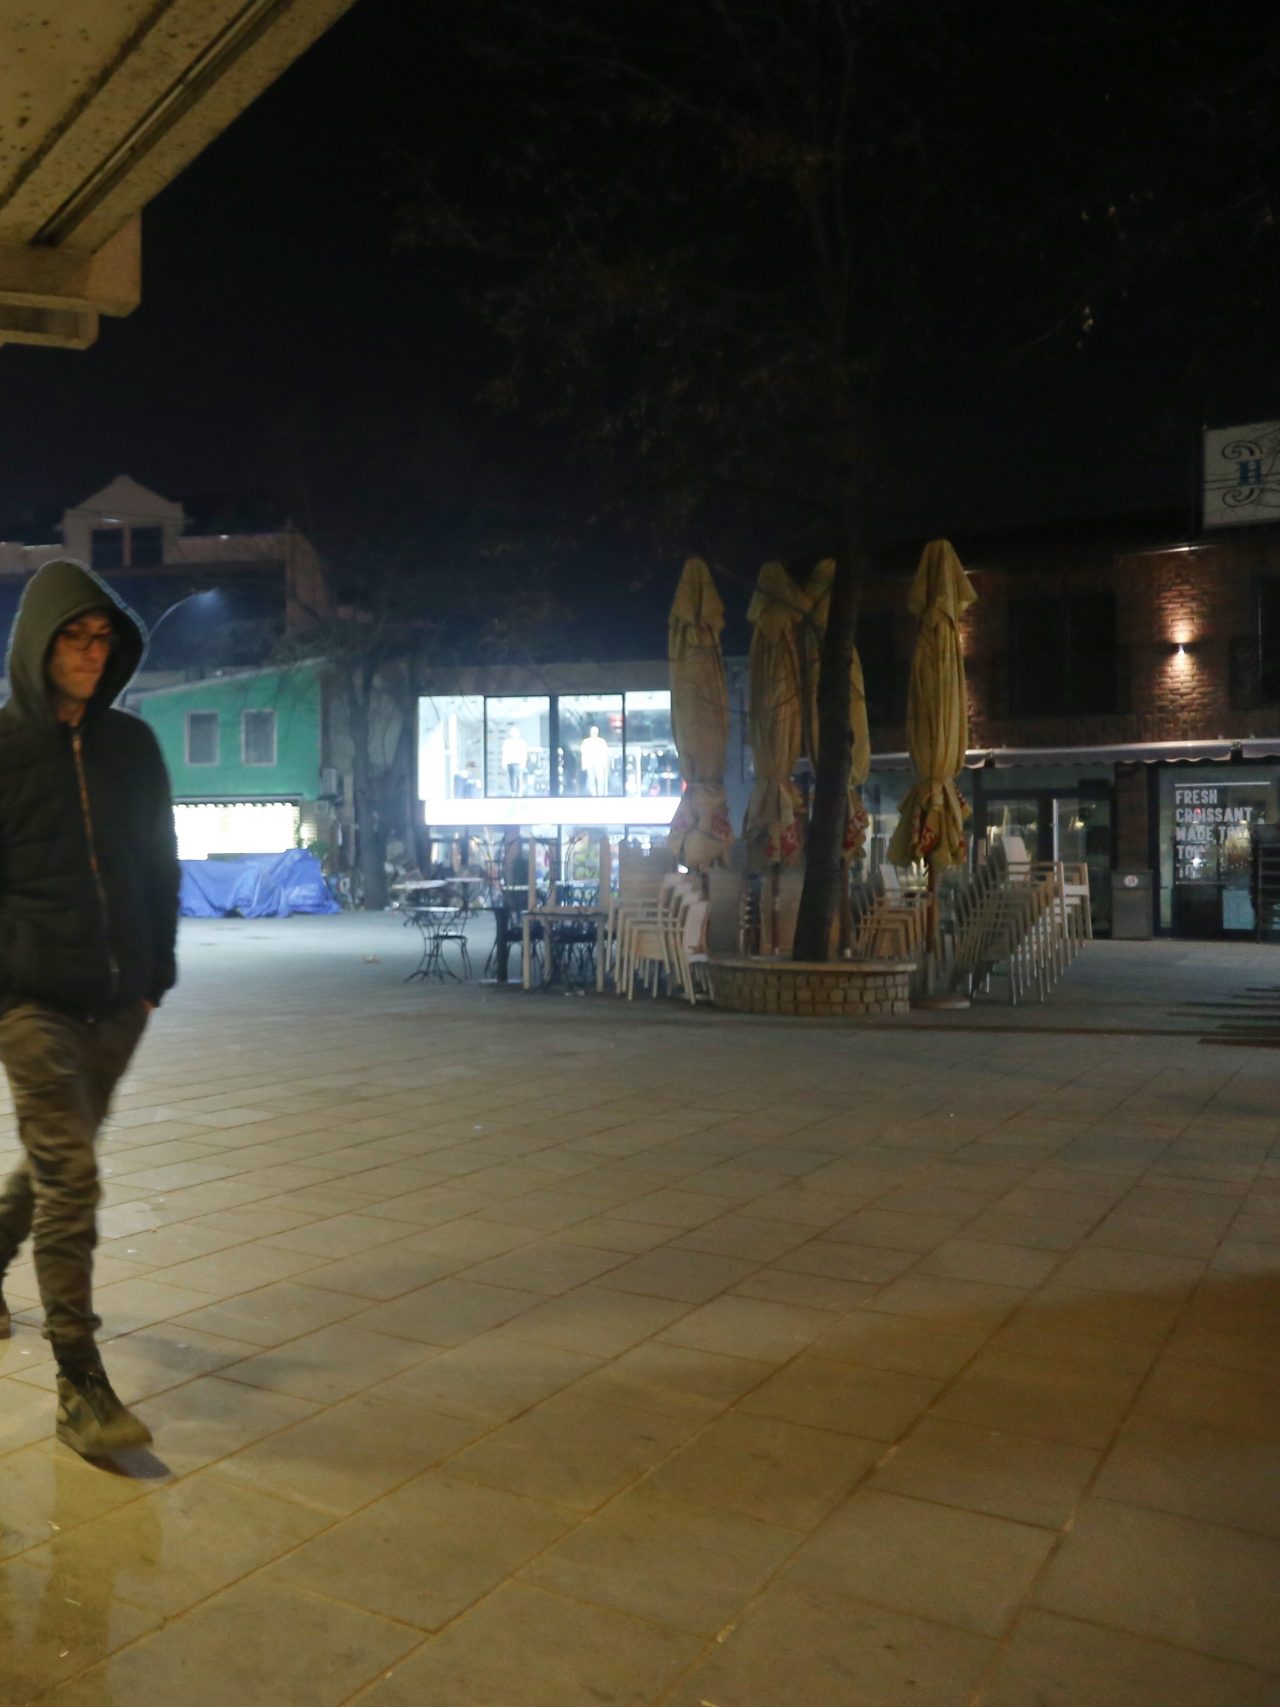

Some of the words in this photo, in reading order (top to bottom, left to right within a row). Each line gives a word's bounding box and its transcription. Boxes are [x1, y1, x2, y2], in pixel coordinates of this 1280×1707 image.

[1175, 789, 1218, 804] FRESH
[1175, 807, 1253, 823] CROISSANT
[1175, 825, 1214, 841] MADE
